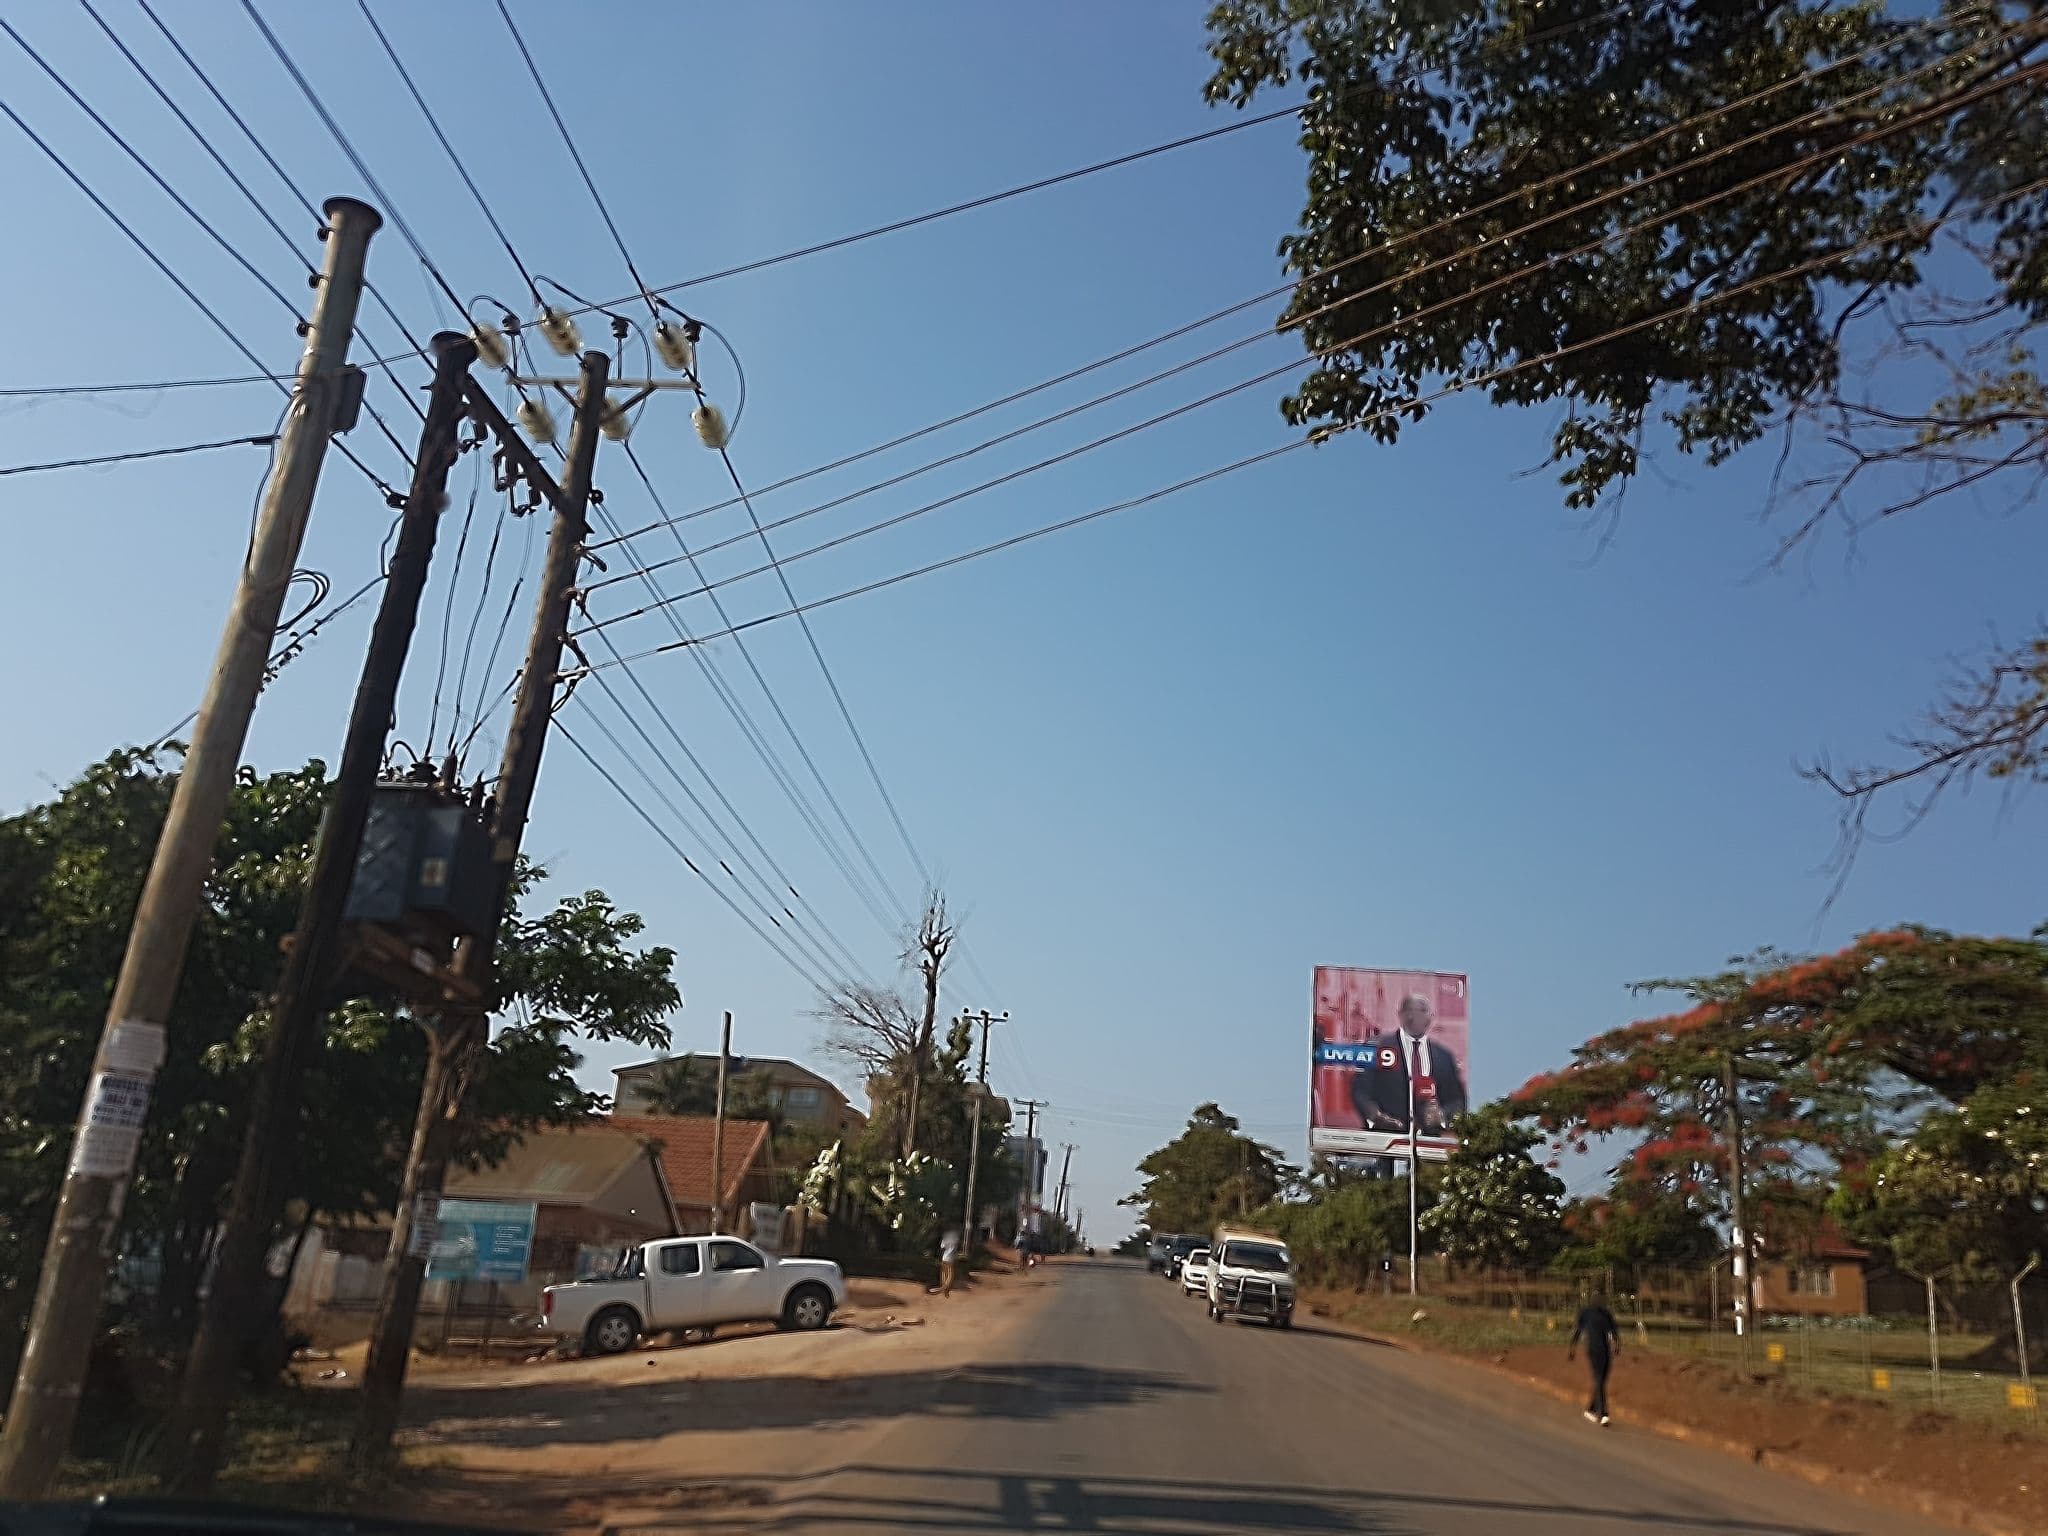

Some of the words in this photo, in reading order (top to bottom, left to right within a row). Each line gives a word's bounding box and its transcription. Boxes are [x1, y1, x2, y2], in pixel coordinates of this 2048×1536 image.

[1324, 1048, 1353, 1060] LIVE
[1356, 1051, 1373, 1062] AT
[1380, 1049, 1396, 1067] 9
